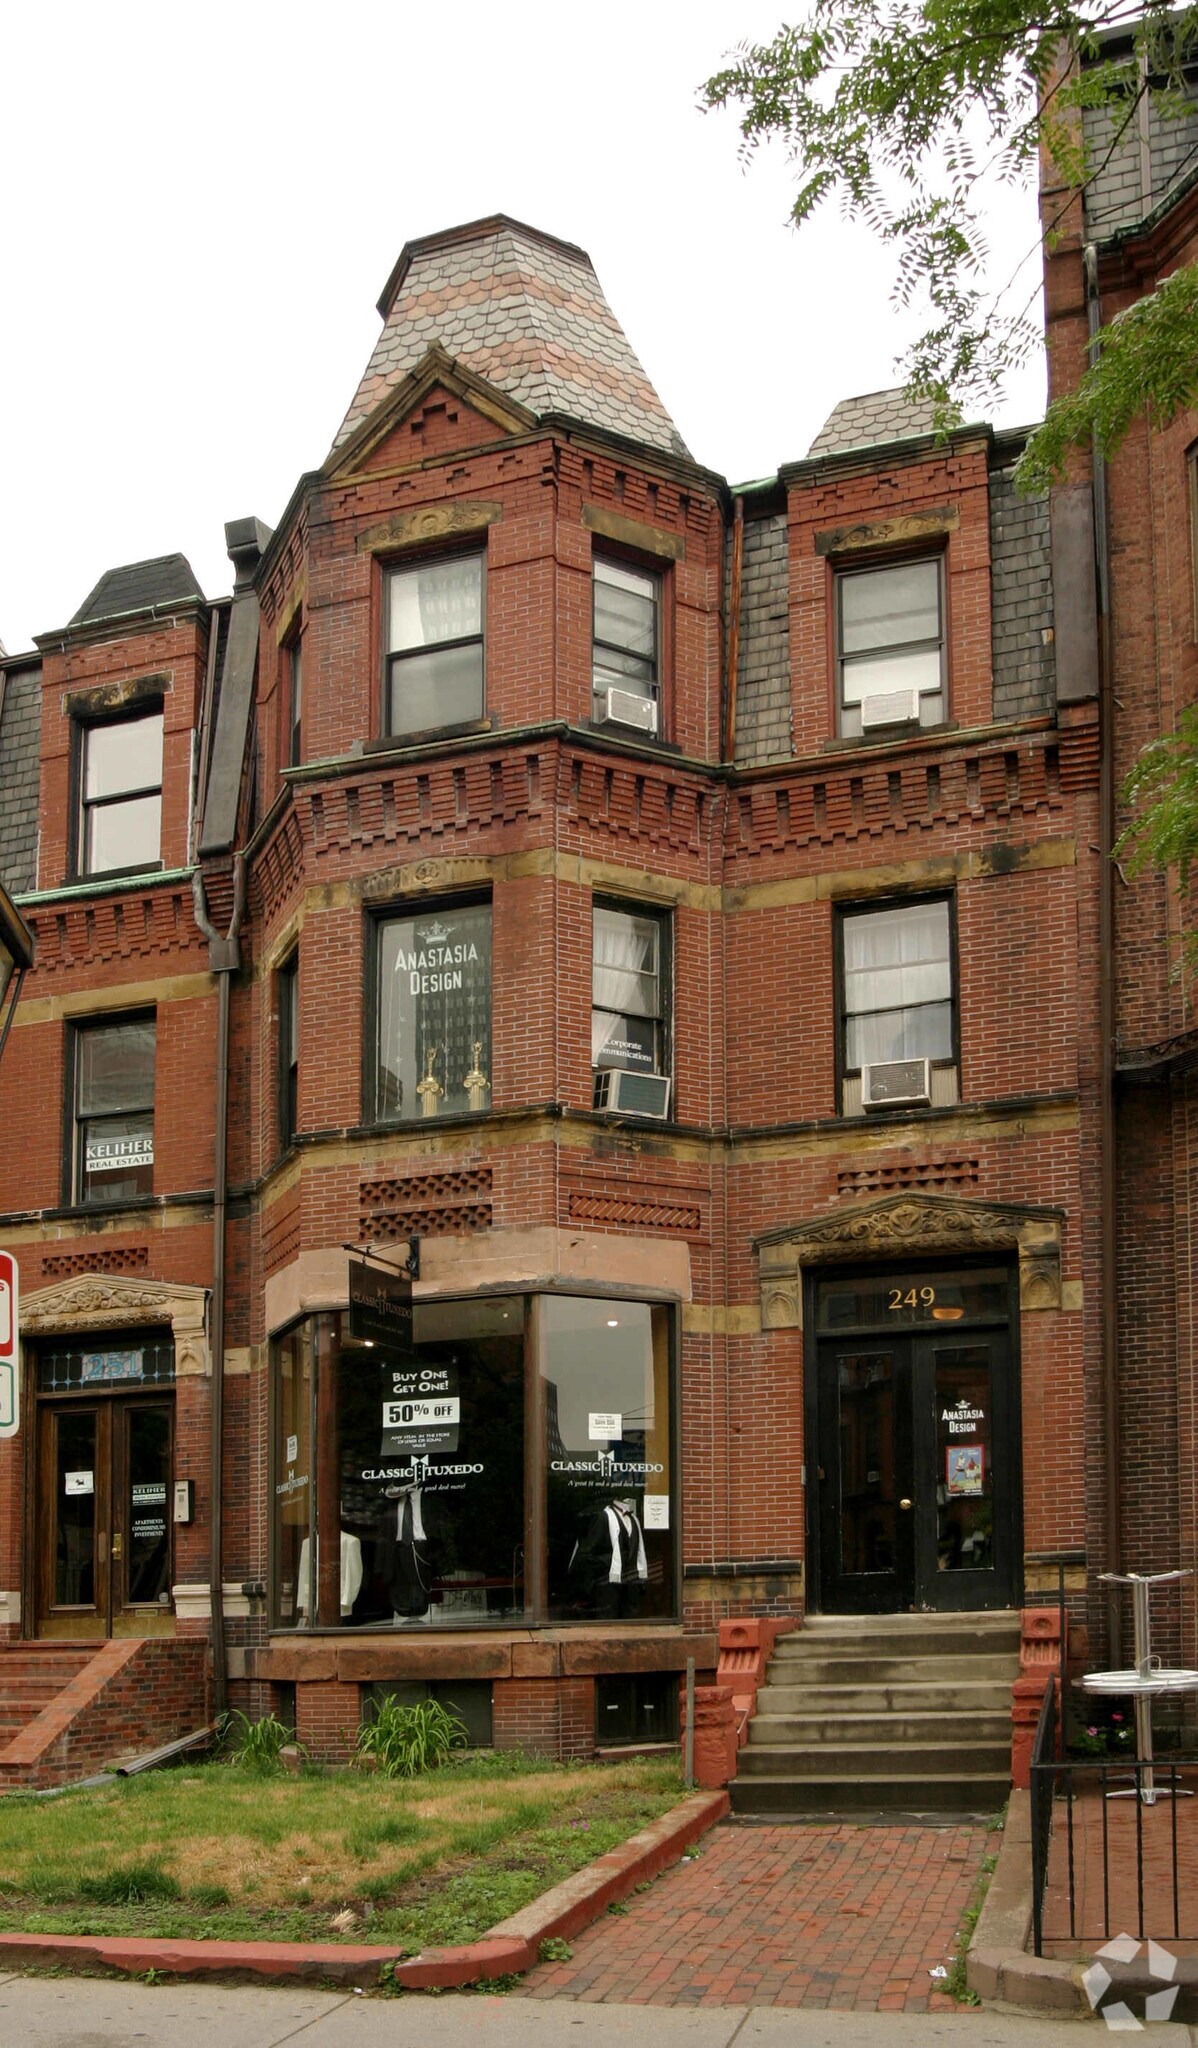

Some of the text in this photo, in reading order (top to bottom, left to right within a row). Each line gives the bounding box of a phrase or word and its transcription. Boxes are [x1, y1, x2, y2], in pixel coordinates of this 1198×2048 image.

[395, 943, 478, 971] ANASTASIA
[410, 970, 462, 995] DESIGN
[87, 1139, 153, 1158] KELIHER
[89, 1155, 151, 1169] REAL ESTATE
[888, 1287, 935, 1309] 249
[88, 1351, 137, 1379] 251
[392, 1370, 448, 1382] BUY ONE
[393, 1380, 449, 1394] GET ONE!
[389, 1404, 453, 1423] 50% OFF
[942, 1409, 985, 1421] ANASTASIA
[948, 1421, 977, 1433] DESIGN
[362, 1463, 484, 1479] CLASSIC TUXEDO
[551, 1460, 664, 1473] CLASSIC TUXEDO
